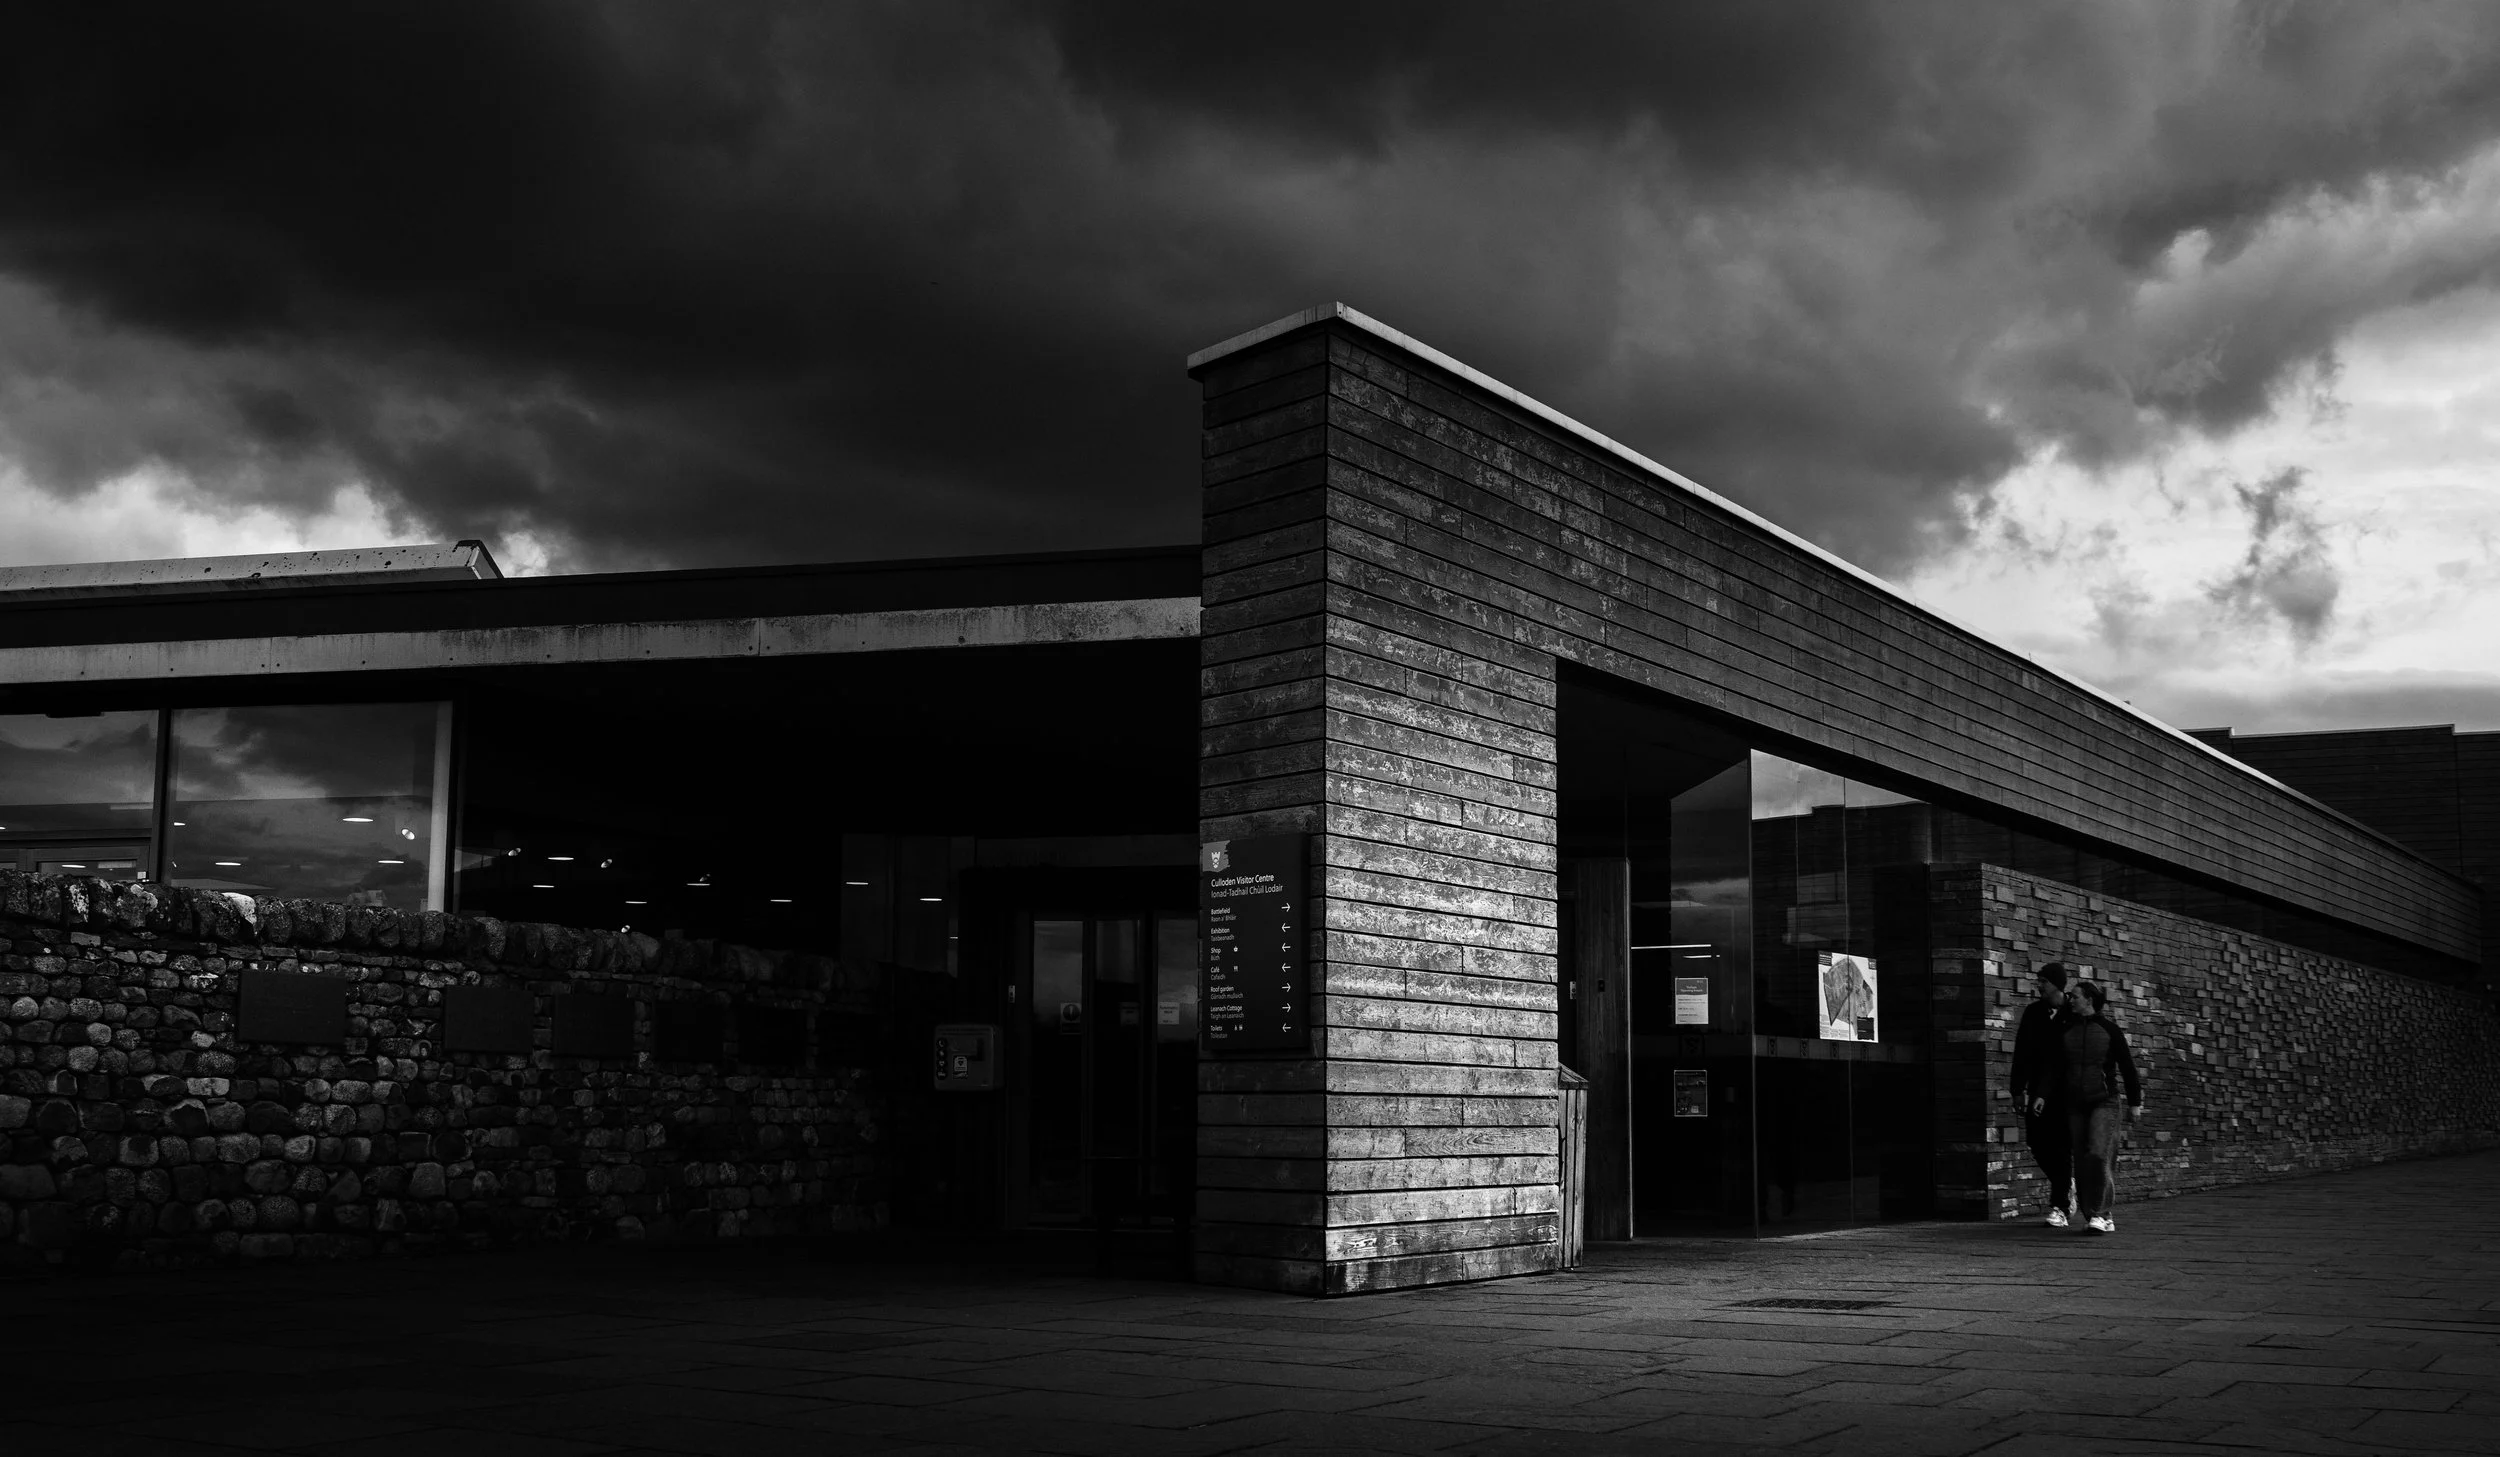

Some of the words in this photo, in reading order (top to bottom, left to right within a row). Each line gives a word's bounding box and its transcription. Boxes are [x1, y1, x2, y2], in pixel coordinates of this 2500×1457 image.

[1211, 878, 1236, 887] Culloden
[1255, 875, 1274, 883] Centre
[1265, 884, 1283, 893] Lodair
